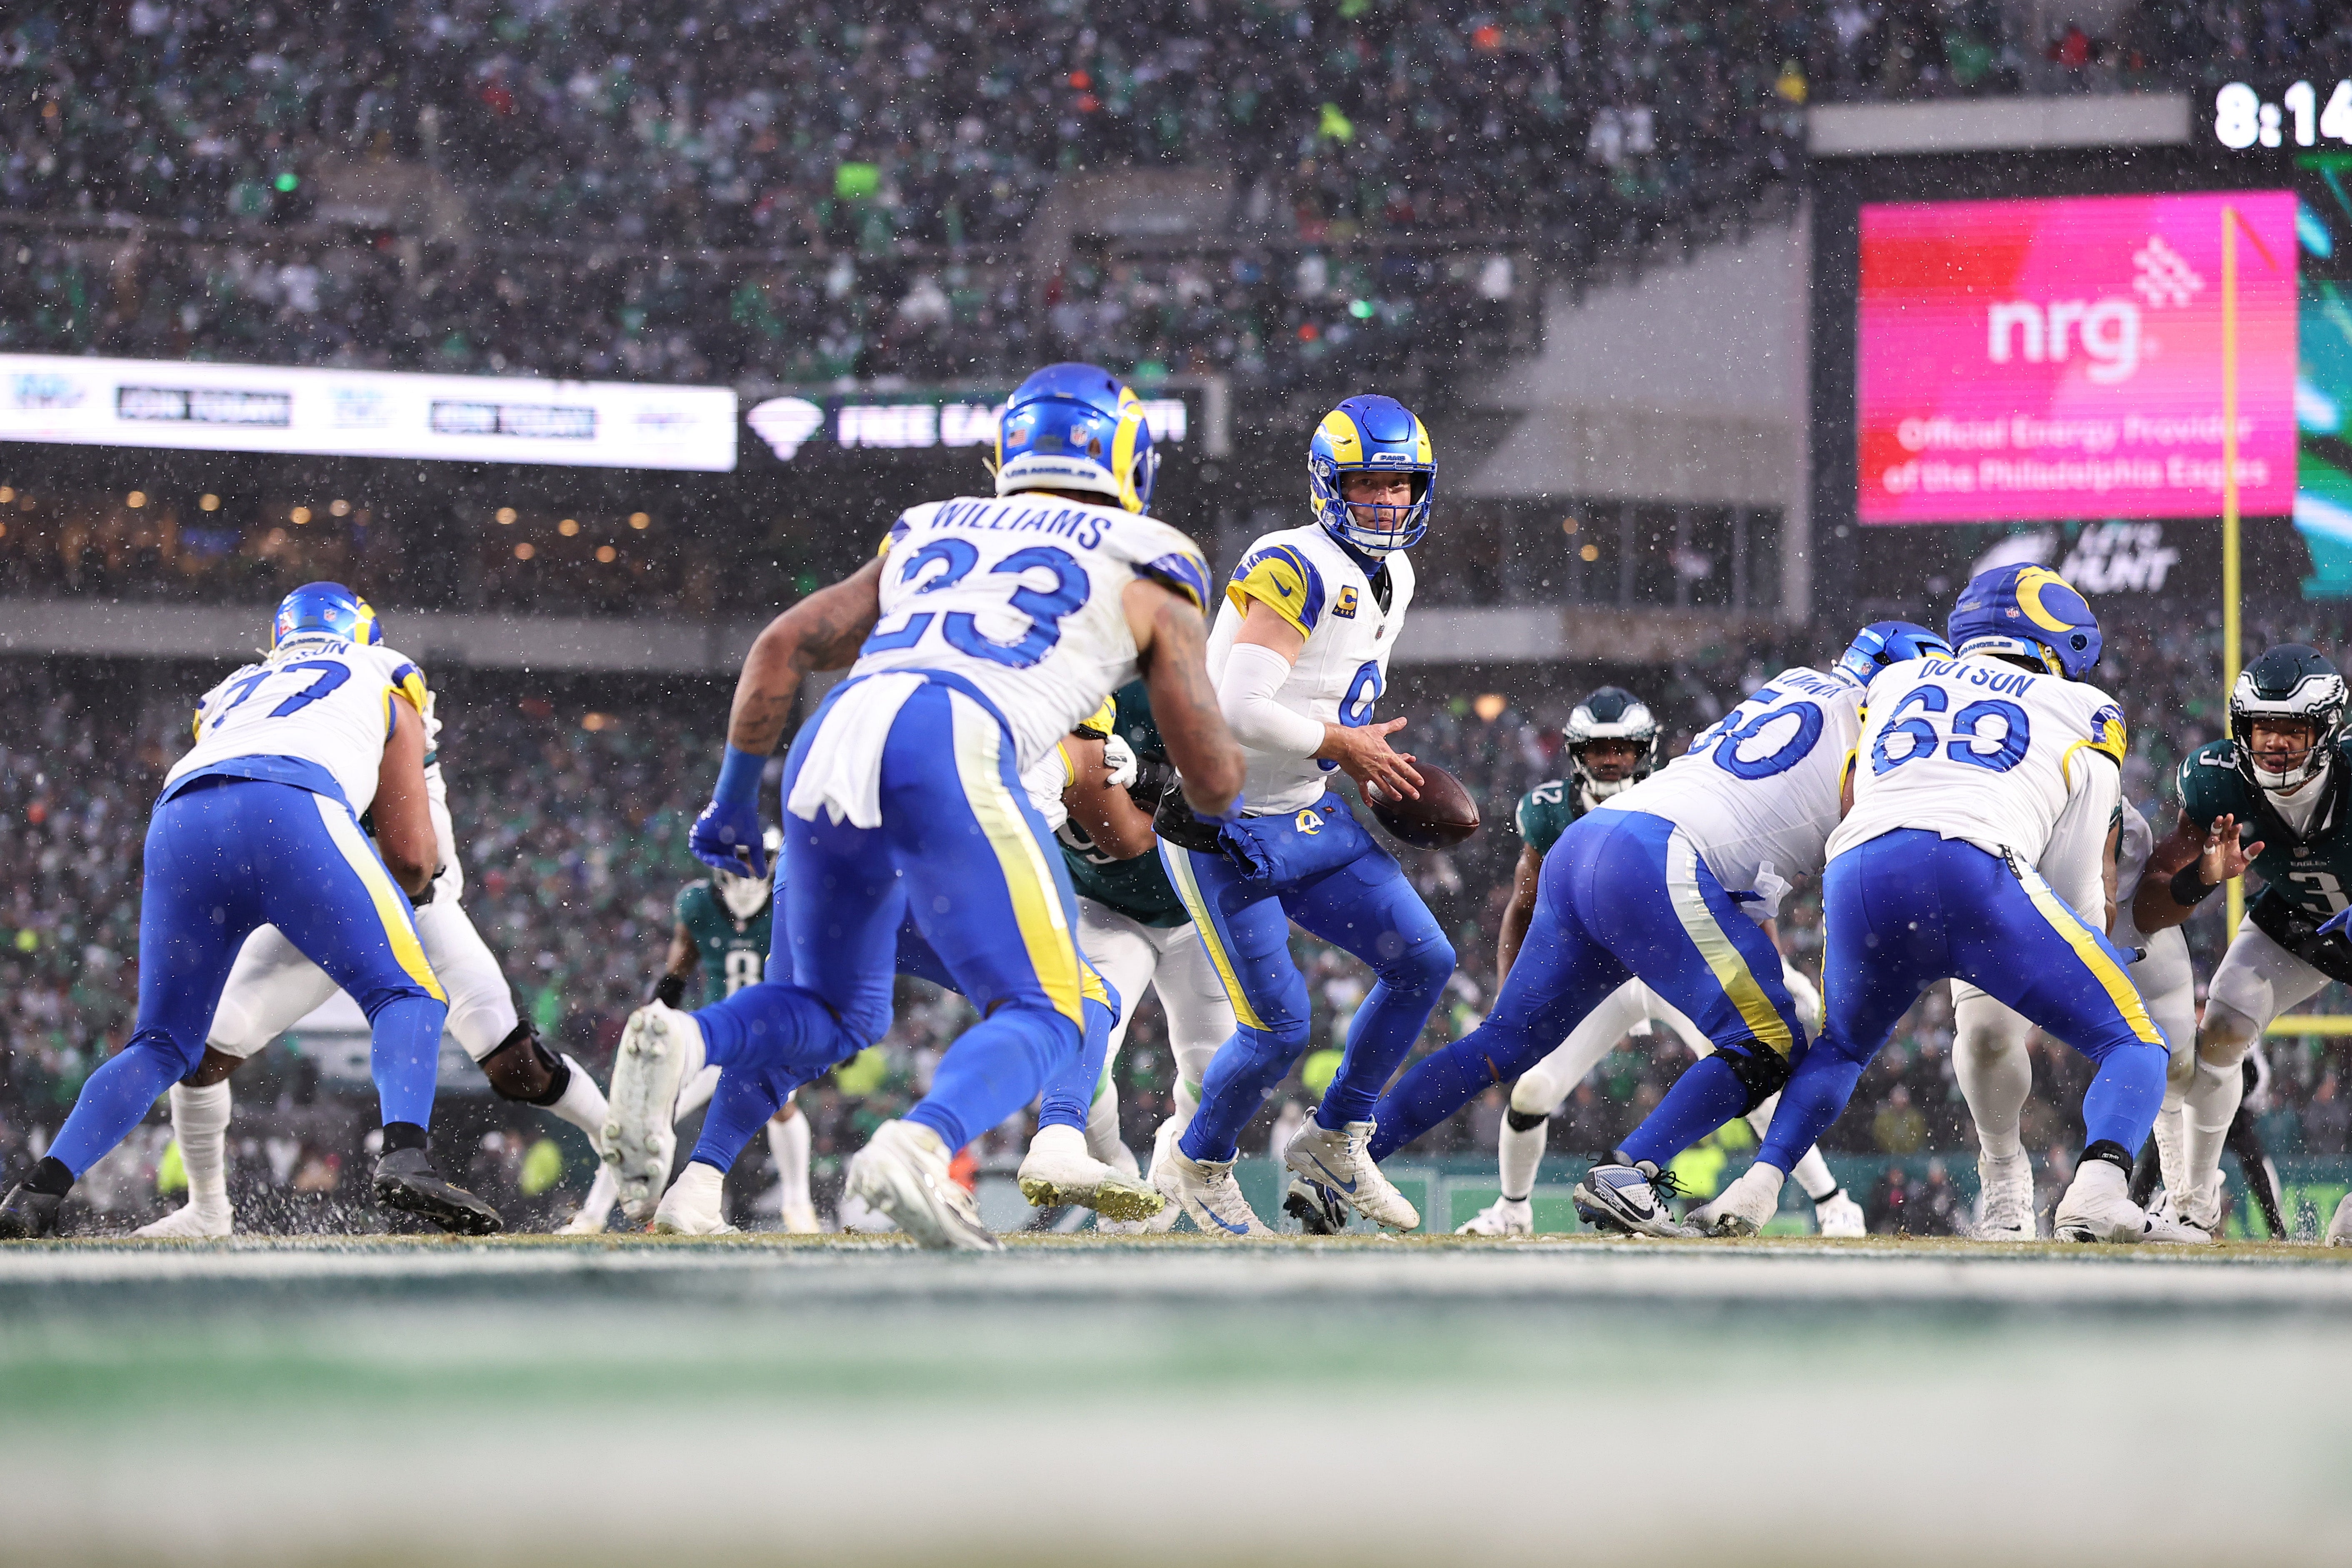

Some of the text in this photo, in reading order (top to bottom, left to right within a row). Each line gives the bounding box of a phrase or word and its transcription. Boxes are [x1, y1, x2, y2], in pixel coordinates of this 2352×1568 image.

[2214, 79, 2352, 149] 8:14
[1987, 298, 2140, 385] nrg
[931, 501, 1112, 550] WILLIAMS
[858, 538, 1090, 669] 23
[212, 660, 351, 729] 77
[1918, 658, 2036, 698] DOTSON
[1871, 684, 2031, 776] 69
[1594, 1188, 1623, 1212] FORCE
